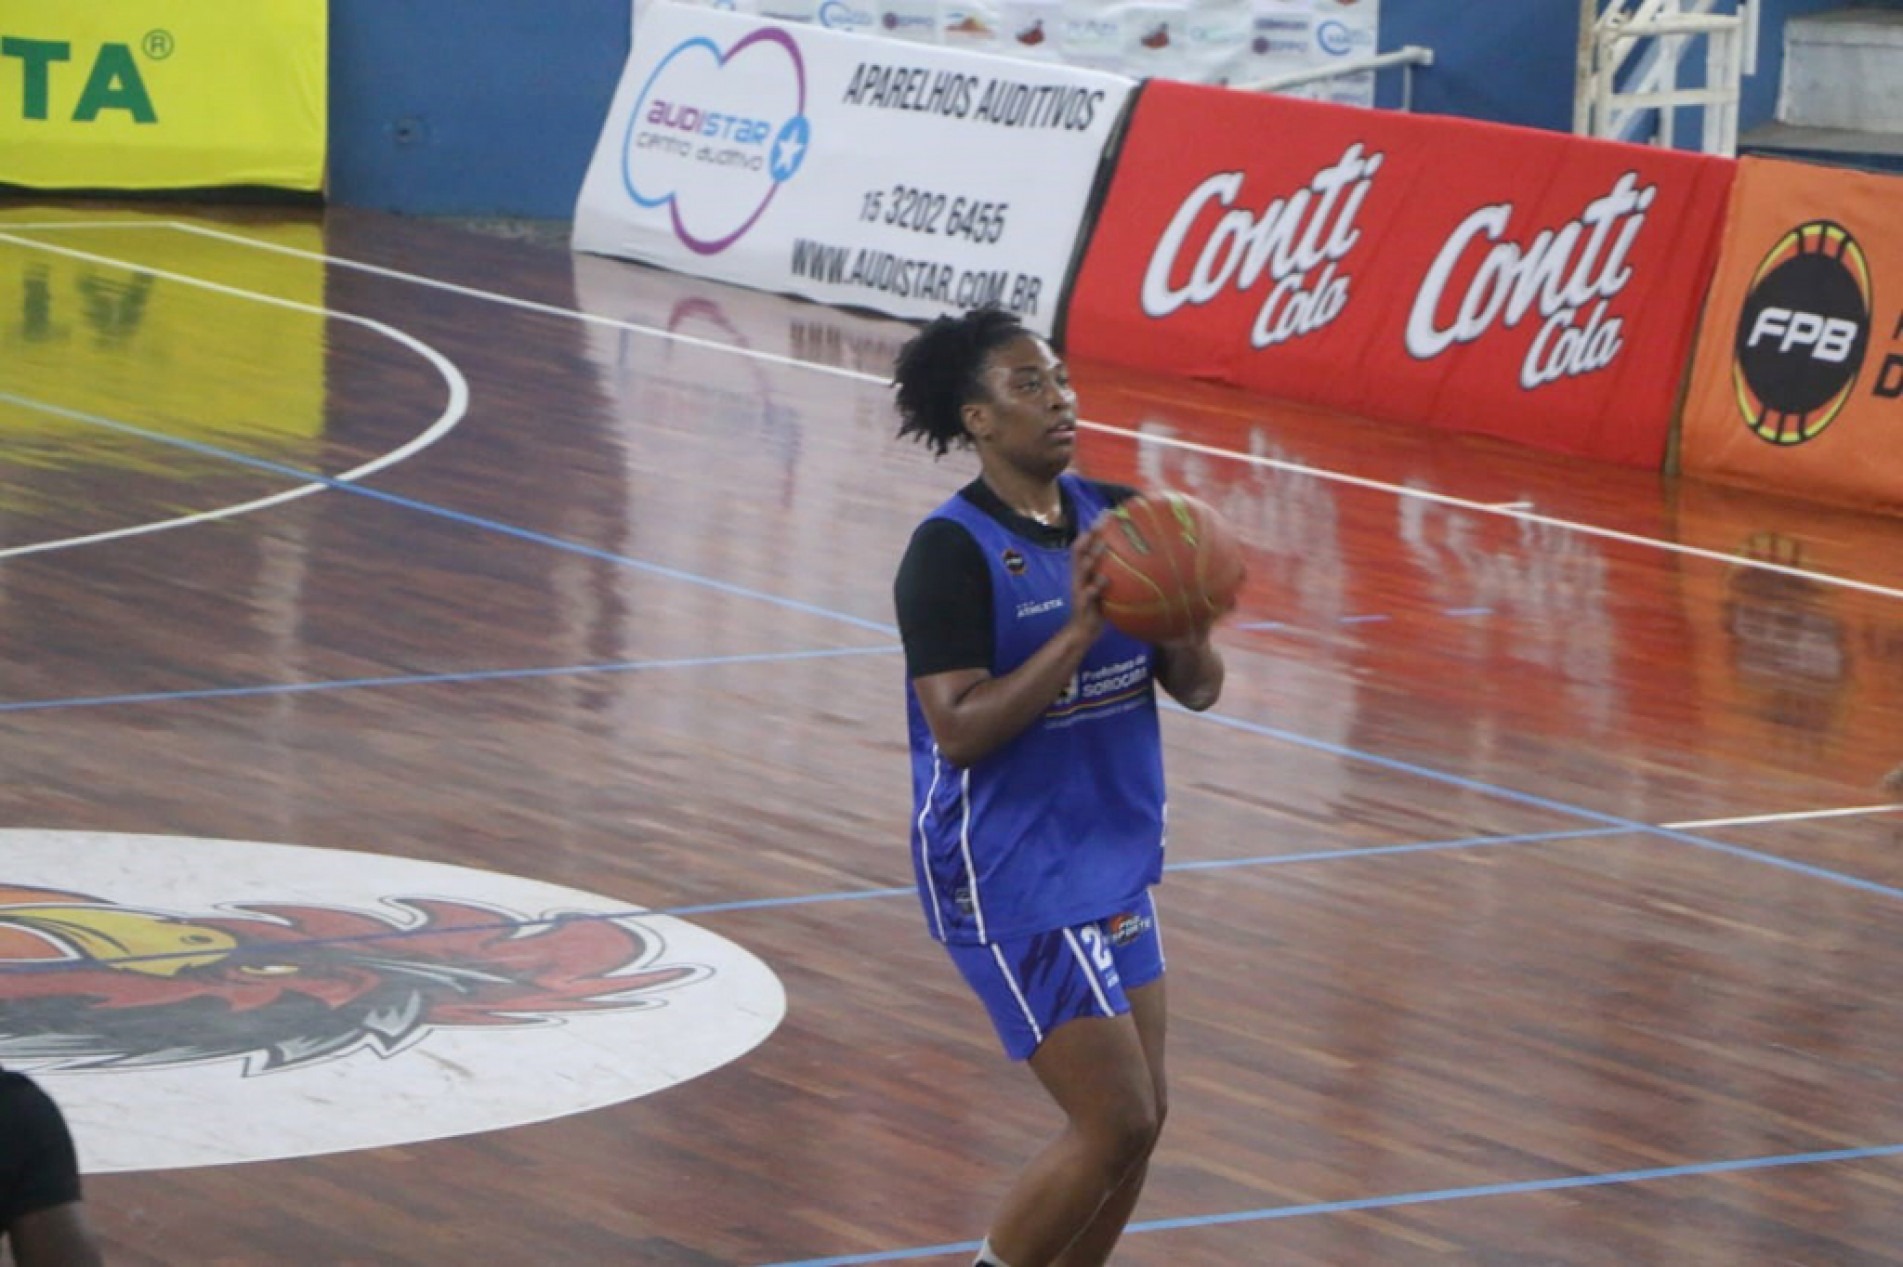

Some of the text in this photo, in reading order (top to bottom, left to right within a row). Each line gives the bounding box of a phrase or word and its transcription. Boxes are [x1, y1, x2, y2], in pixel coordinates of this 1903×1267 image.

[841, 62, 1105, 131] APARELHOS AUDITIVOS
[636, 131, 763, 171] centro auditivo
[859, 184, 1010, 244] 15 3202 6455
[1141, 140, 1384, 318] Conti
[790, 237, 1043, 315] WWW.AUDISTAR.COM.BR
[1405, 170, 1659, 360] Conti
[1250, 261, 1351, 350] Cola
[1746, 306, 1858, 363] FPB
[1519, 300, 1623, 391] Cola
